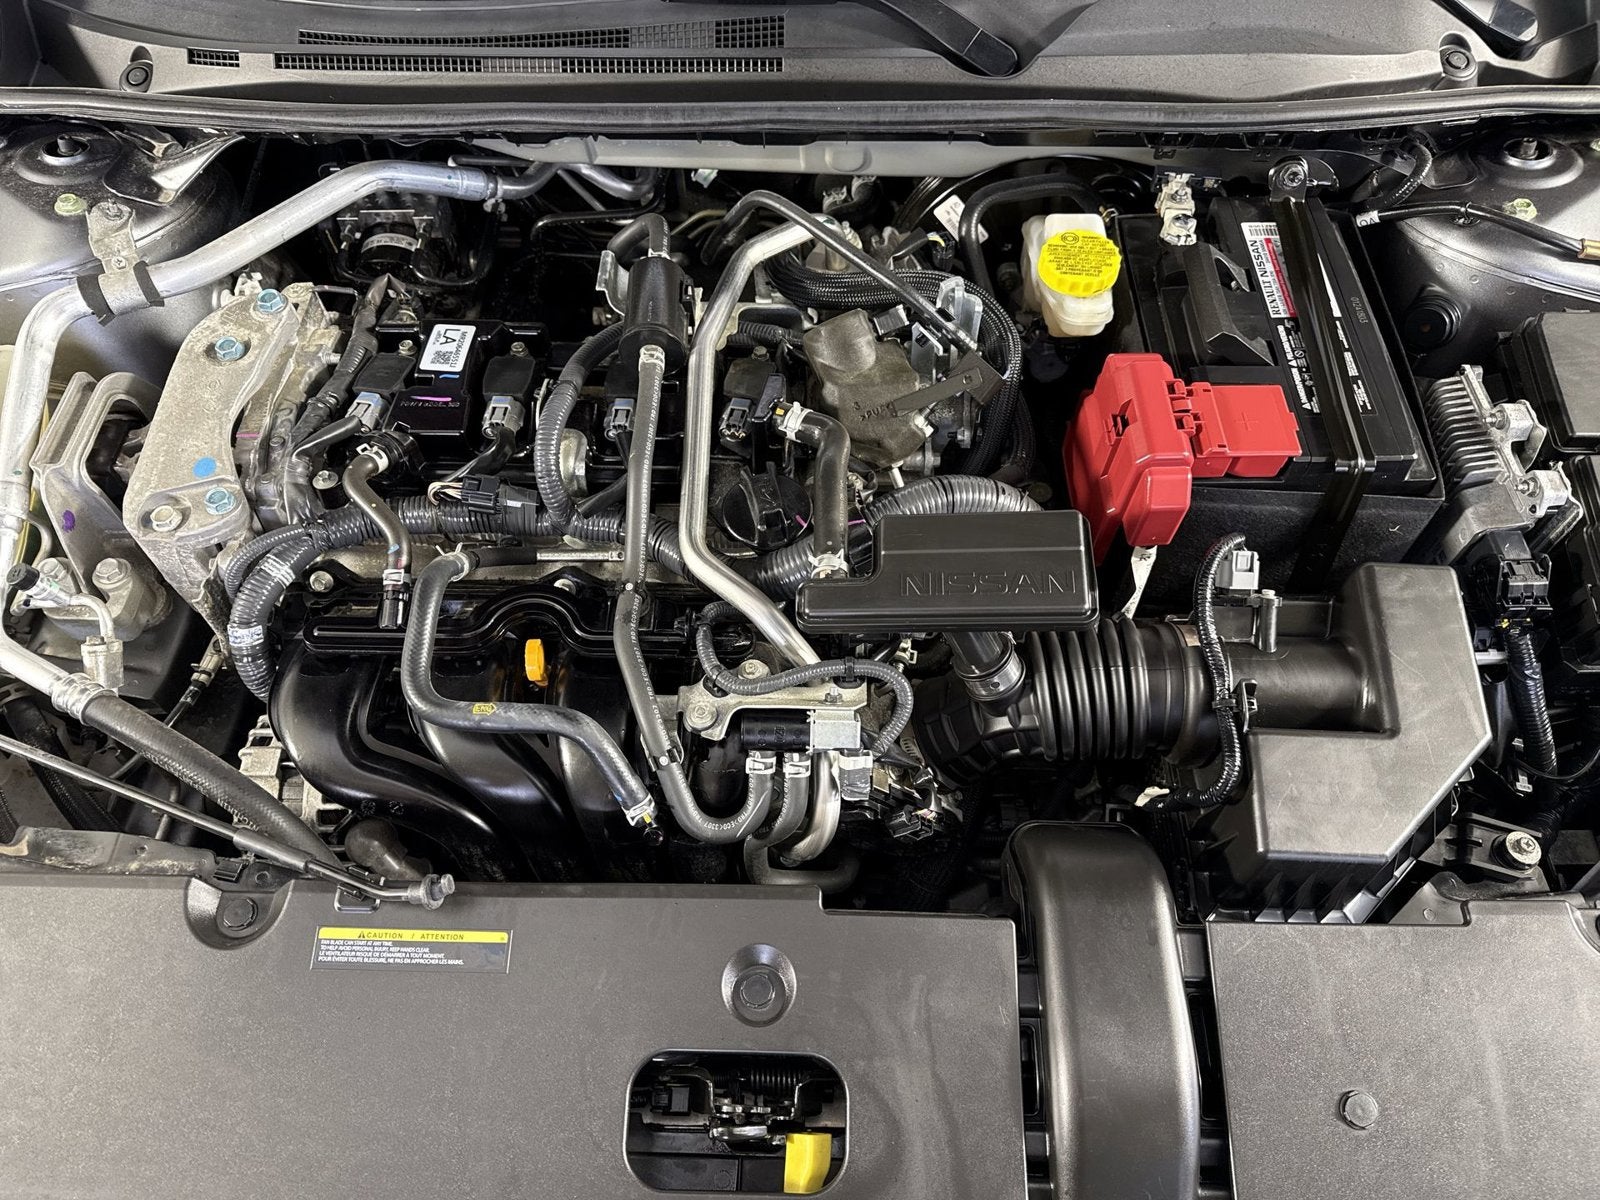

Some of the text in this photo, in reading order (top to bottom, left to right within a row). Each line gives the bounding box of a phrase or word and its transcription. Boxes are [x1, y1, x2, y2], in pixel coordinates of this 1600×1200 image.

[1250, 239, 1268, 278] NISSAN
[1261, 278, 1281, 316] RENAULT
[439, 328, 461, 346] LA
[900, 571, 1077, 596] NISSAN
